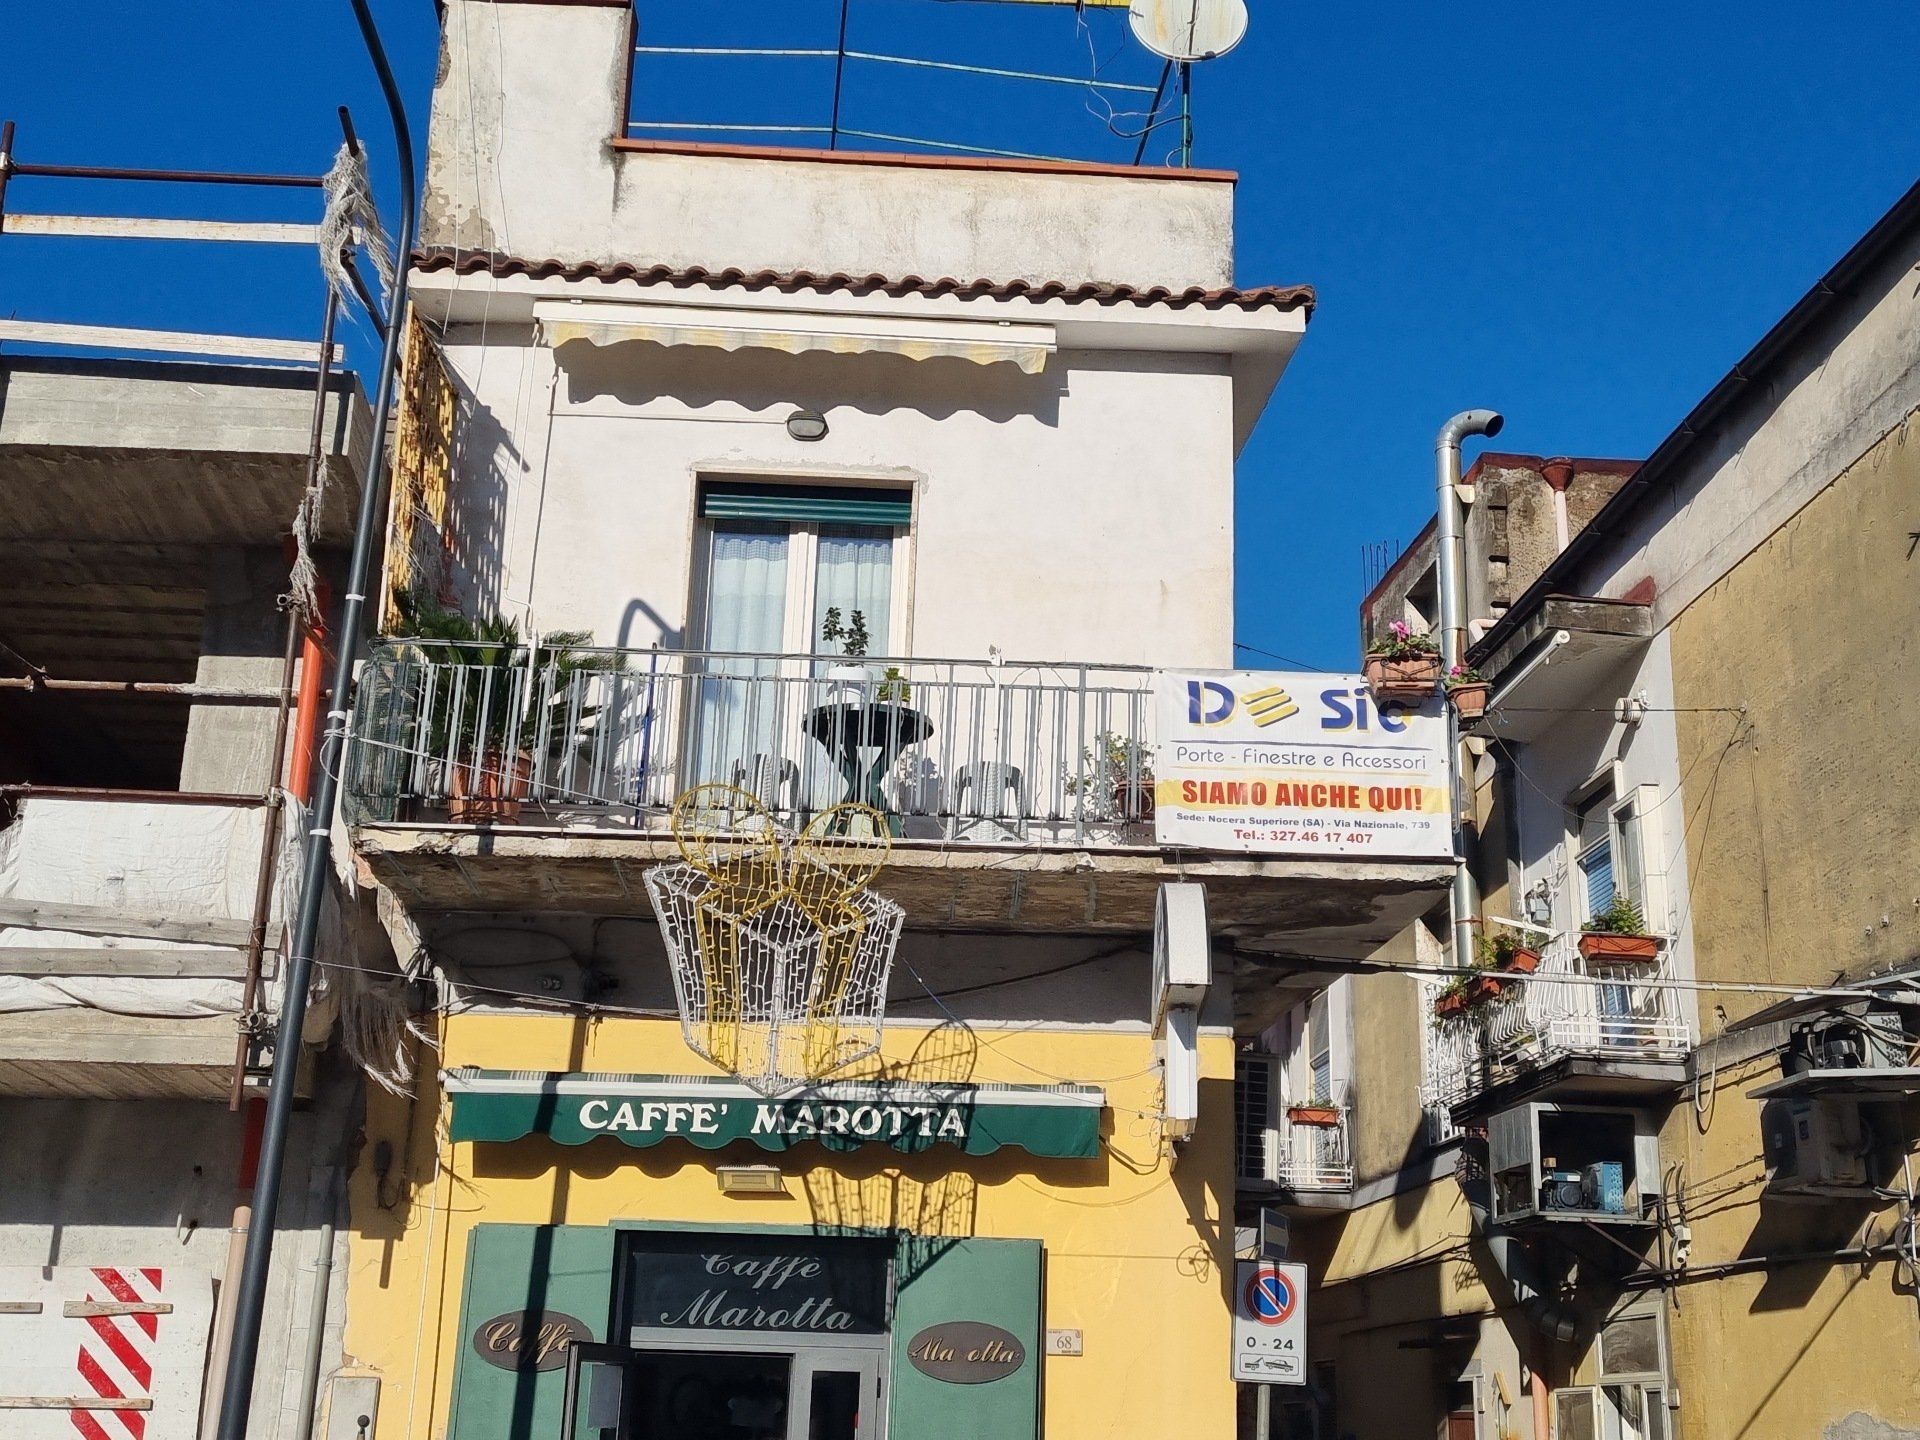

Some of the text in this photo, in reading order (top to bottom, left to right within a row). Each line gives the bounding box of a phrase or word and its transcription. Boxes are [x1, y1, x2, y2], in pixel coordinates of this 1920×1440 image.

[1176, 746, 1224, 763] Porte
[1243, 747, 1316, 766] Finestre
[1323, 755, 1335, 767] e
[1342, 751, 1426, 769] Accessori
[1182, 780, 1422, 812] SIAMO ANCHE QUI!
[1176, 812, 1205, 822] Sede:
[1208, 815, 1246, 824] Nocera
[1249, 817, 1300, 827] Superiore
[1302, 818, 1325, 828] (SA)
[1334, 819, 1351, 828] Via
[1354, 820, 1408, 830] Nazionale,
[1411, 821, 1431, 829] 739
[1233, 829, 1373, 844] Tel.: 327.46 17 407
[579, 1099, 966, 1137] CAFFE' MAROTTA
[660, 1289, 855, 1330] Marotta
[1056, 1335, 1072, 1349] 68
[1272, 1338, 1294, 1350] 24
